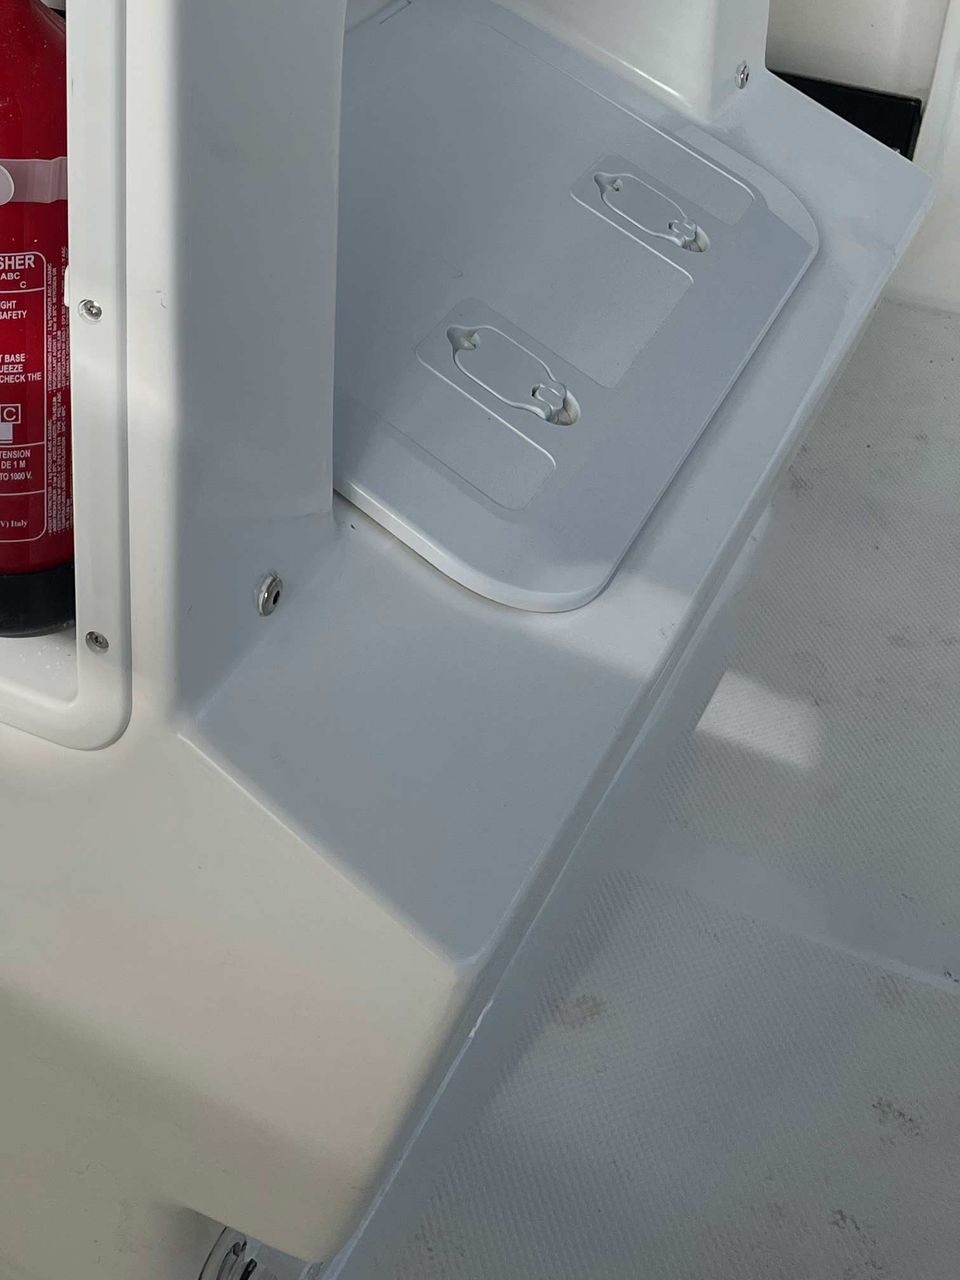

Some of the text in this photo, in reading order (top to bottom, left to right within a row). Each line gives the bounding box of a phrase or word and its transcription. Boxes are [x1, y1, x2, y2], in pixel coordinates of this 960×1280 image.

[0, 271, 21, 280] ABC
[19, 280, 27, 289] C
[4, 352, 27, 363] BASE
[27, 371, 43, 381] THE
[3, 407, 16, 421] C
[0, 460, 12, 469] DE
[13, 460, 18, 469] 1
[18, 459, 26, 469] M
[0, 472, 10, 481] TO
[10, 471, 26, 481] 1000
[10, 518, 29, 529] Italy
